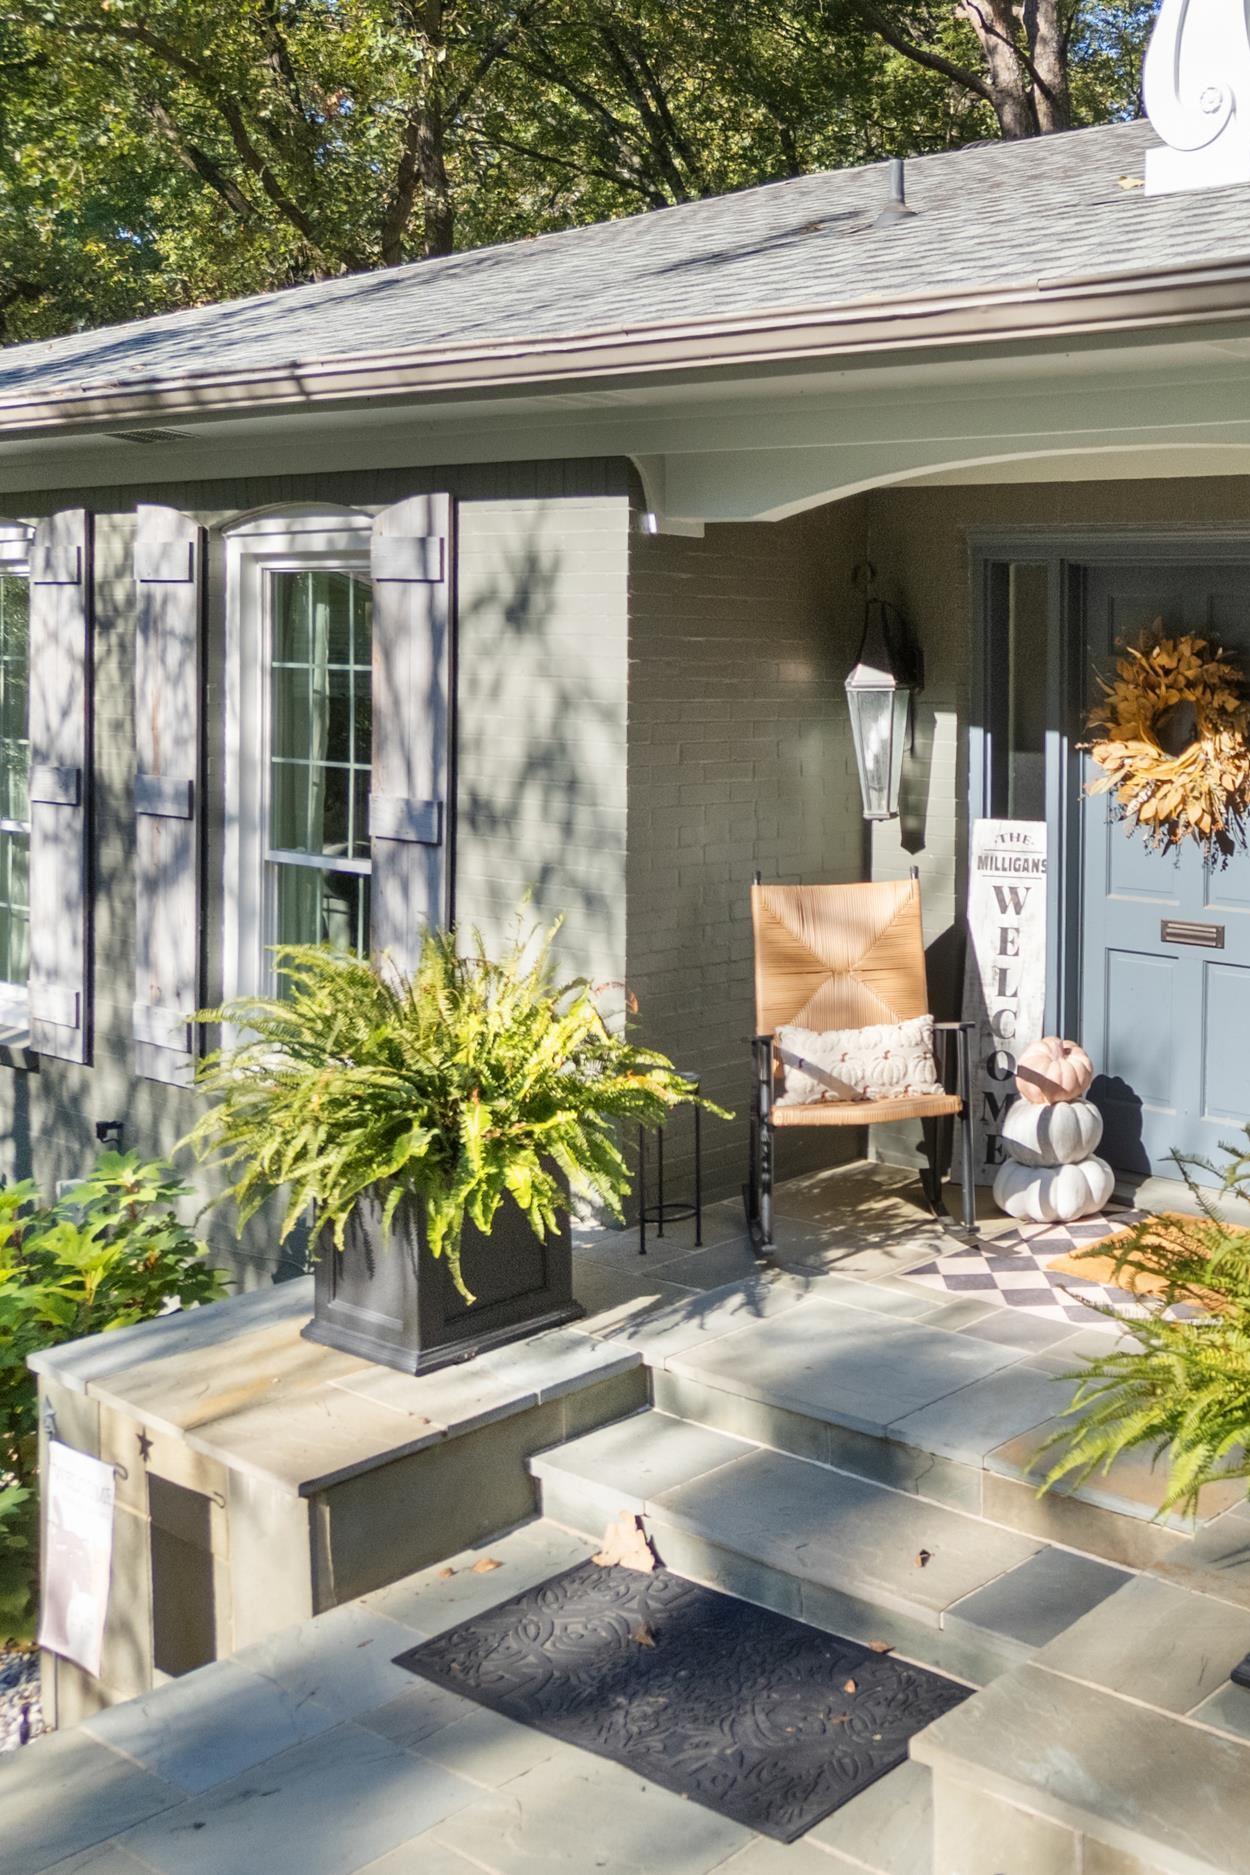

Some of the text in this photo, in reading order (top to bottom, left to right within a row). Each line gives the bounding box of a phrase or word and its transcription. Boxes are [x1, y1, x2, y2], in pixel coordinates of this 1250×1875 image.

[995, 832, 1033, 846] THE
[977, 855, 1048, 874] MILLIGANS
[980, 885, 1031, 1165] WELCOME
